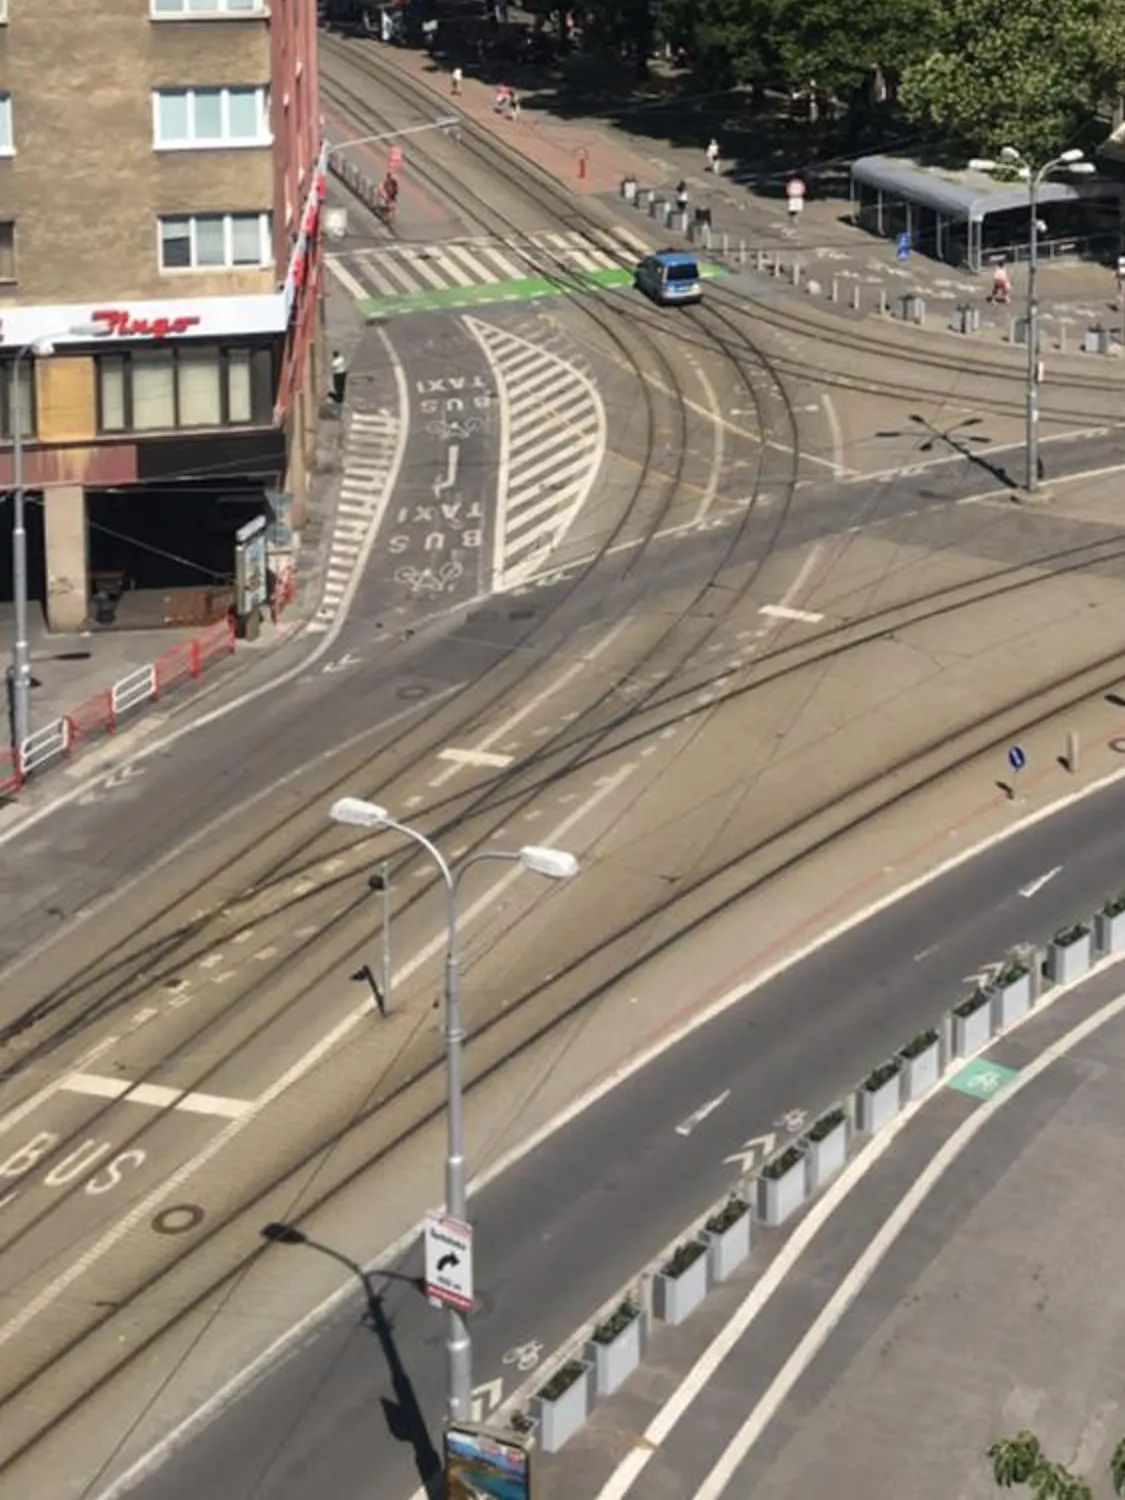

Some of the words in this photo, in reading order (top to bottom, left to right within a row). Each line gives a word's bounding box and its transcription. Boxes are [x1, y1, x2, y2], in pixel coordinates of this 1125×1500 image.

[416, 376, 486, 394] TAXI
[420, 396, 490, 414] BUS
[397, 501, 484, 523] TAXI
[388, 529, 483, 554] BUS
[0, 1132, 146, 1196] BUS
